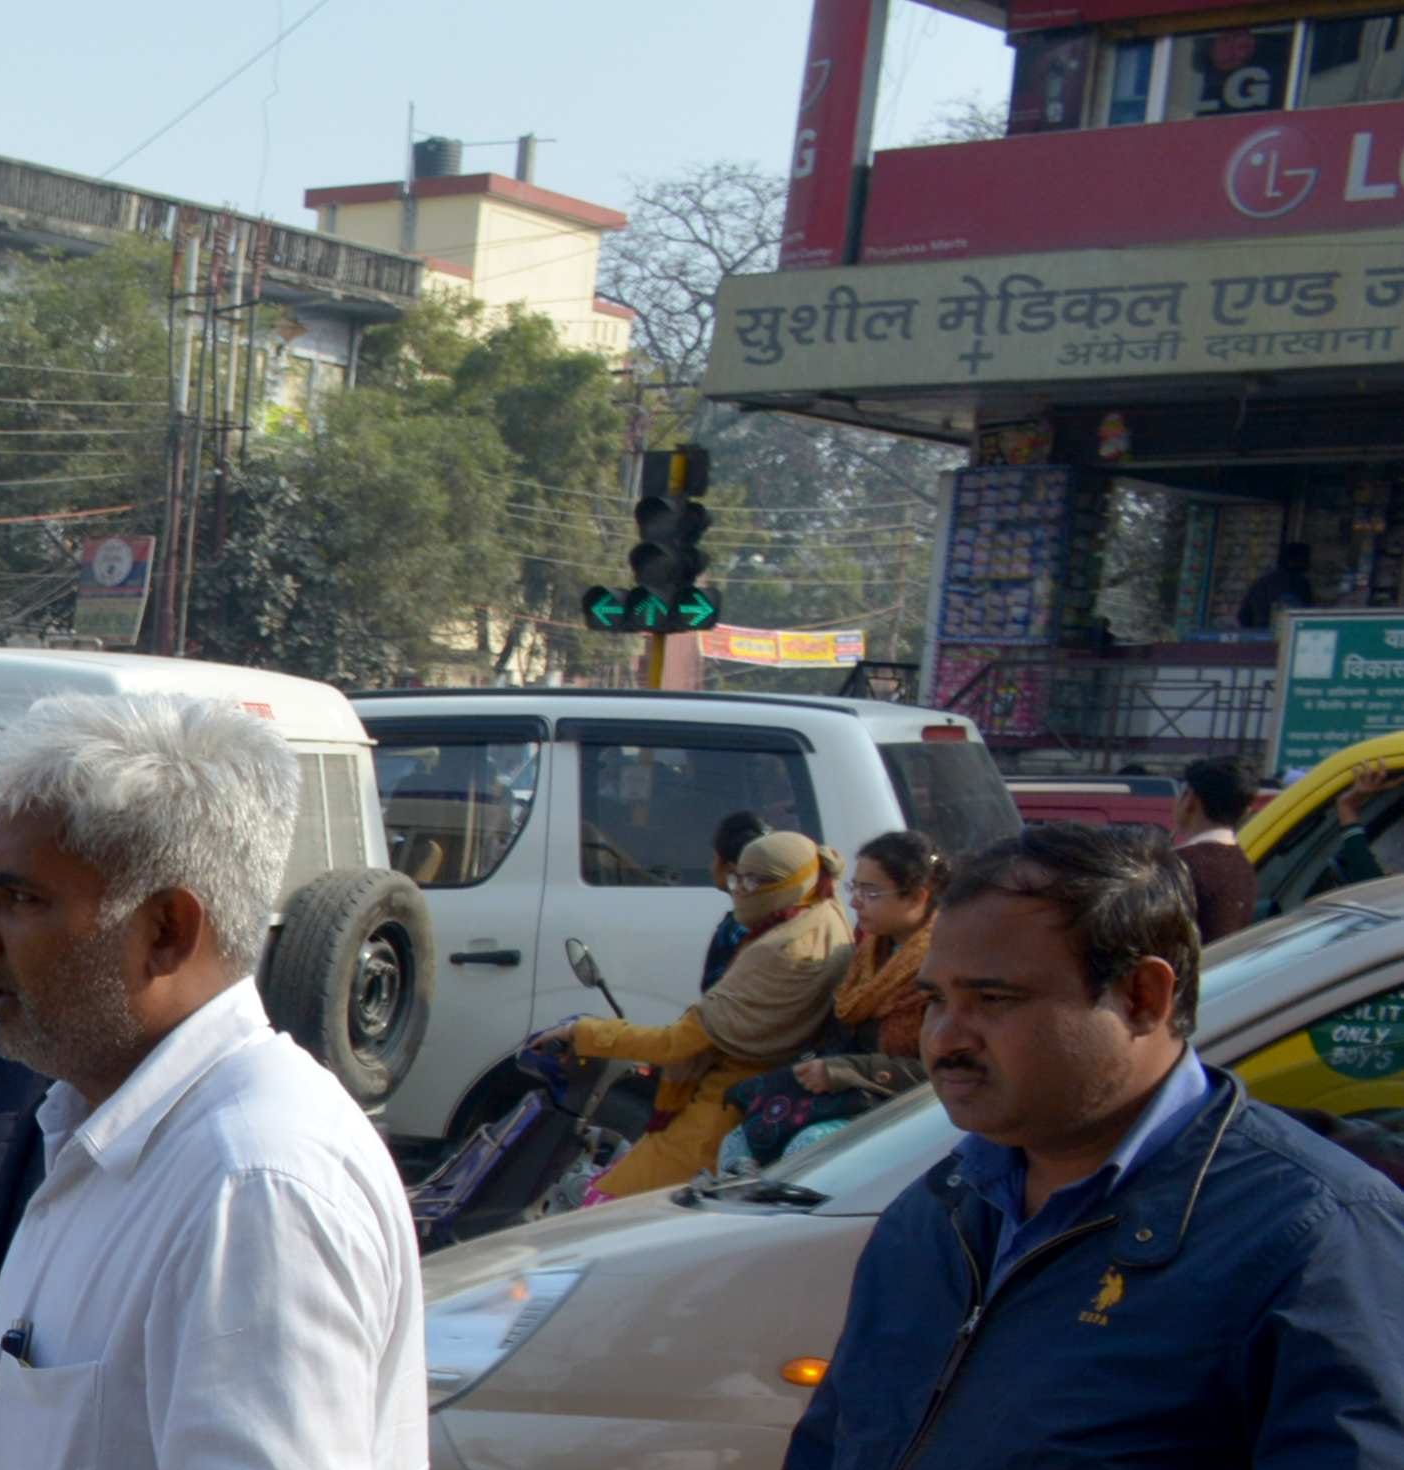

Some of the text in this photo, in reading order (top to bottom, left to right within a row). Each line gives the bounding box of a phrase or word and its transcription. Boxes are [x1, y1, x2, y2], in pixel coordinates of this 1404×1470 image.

[735, 285, 921, 366] सुशील
[938, 273, 1186, 337] मेडिकल
[1210, 270, 1340, 326] एण्ड
[1056, 323, 1399, 368] अंग्रेजी दवाखाना
[1331, 1024, 1391, 1045] ONLY
